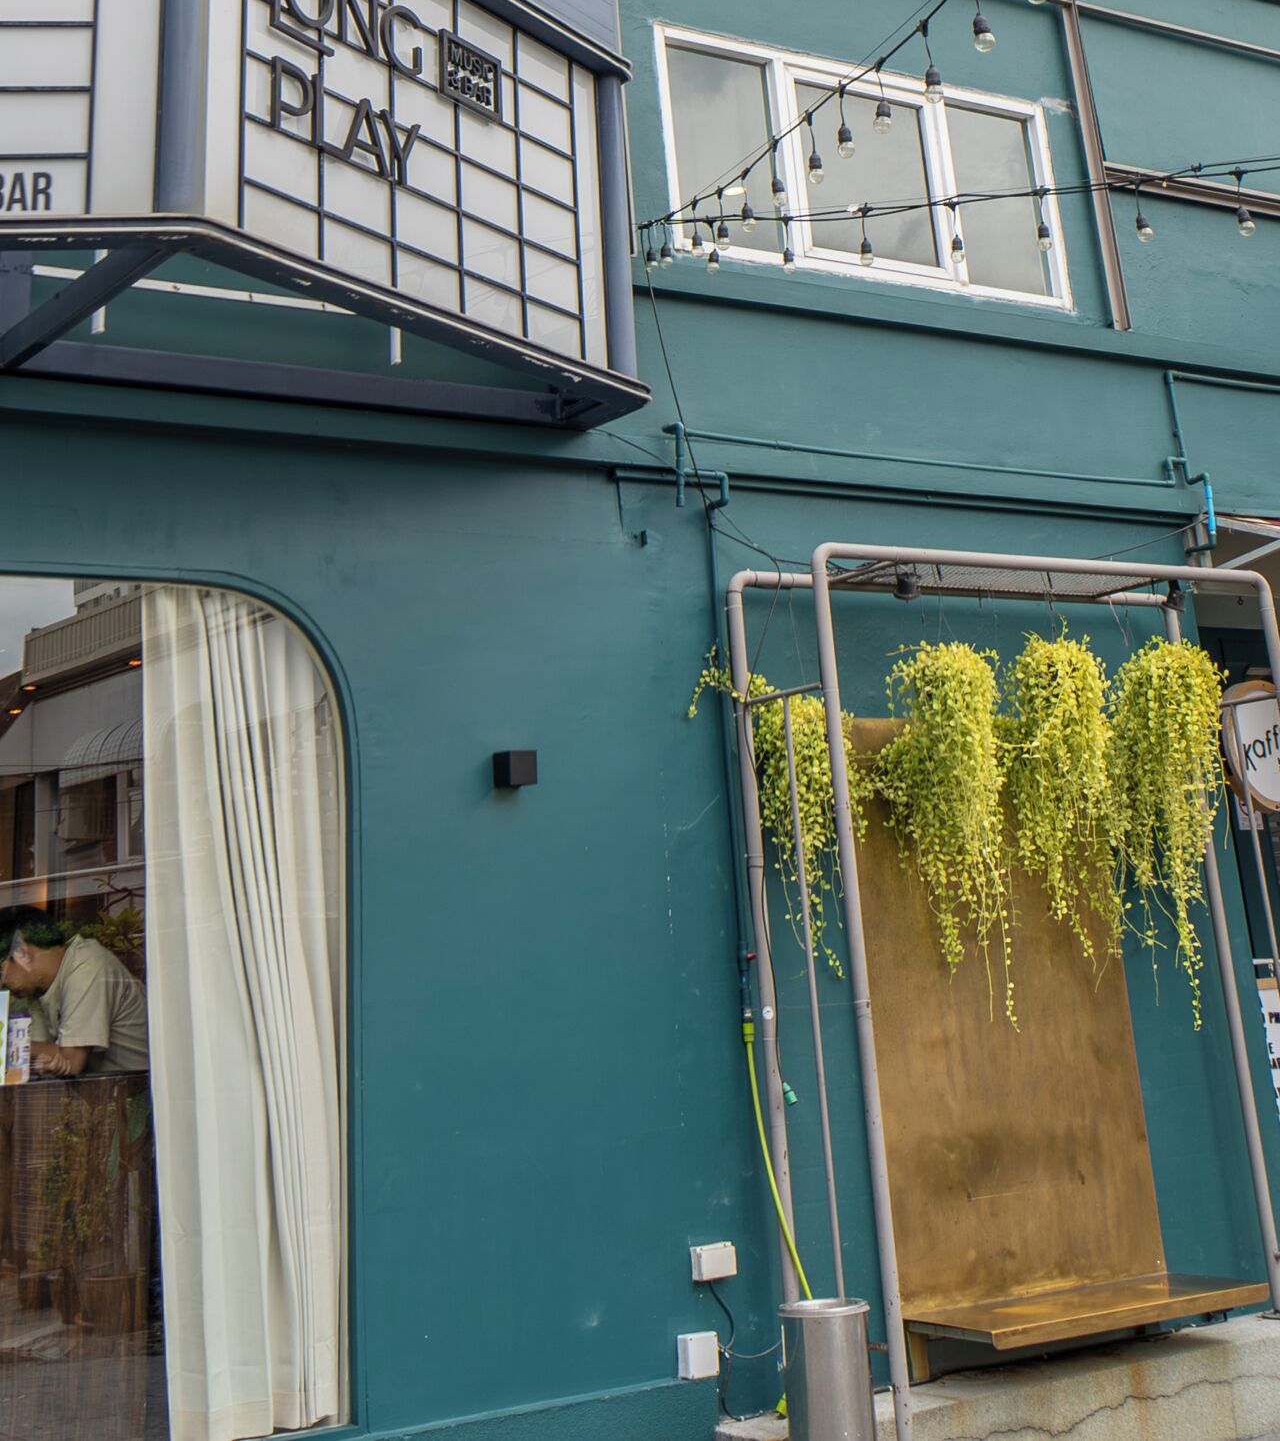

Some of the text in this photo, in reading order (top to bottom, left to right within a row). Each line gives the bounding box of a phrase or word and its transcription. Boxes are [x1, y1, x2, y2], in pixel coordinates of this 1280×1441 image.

[448, 42, 495, 83] MUSIC
[460, 75, 493, 106] BAR
[270, 55, 422, 187] PLAY
